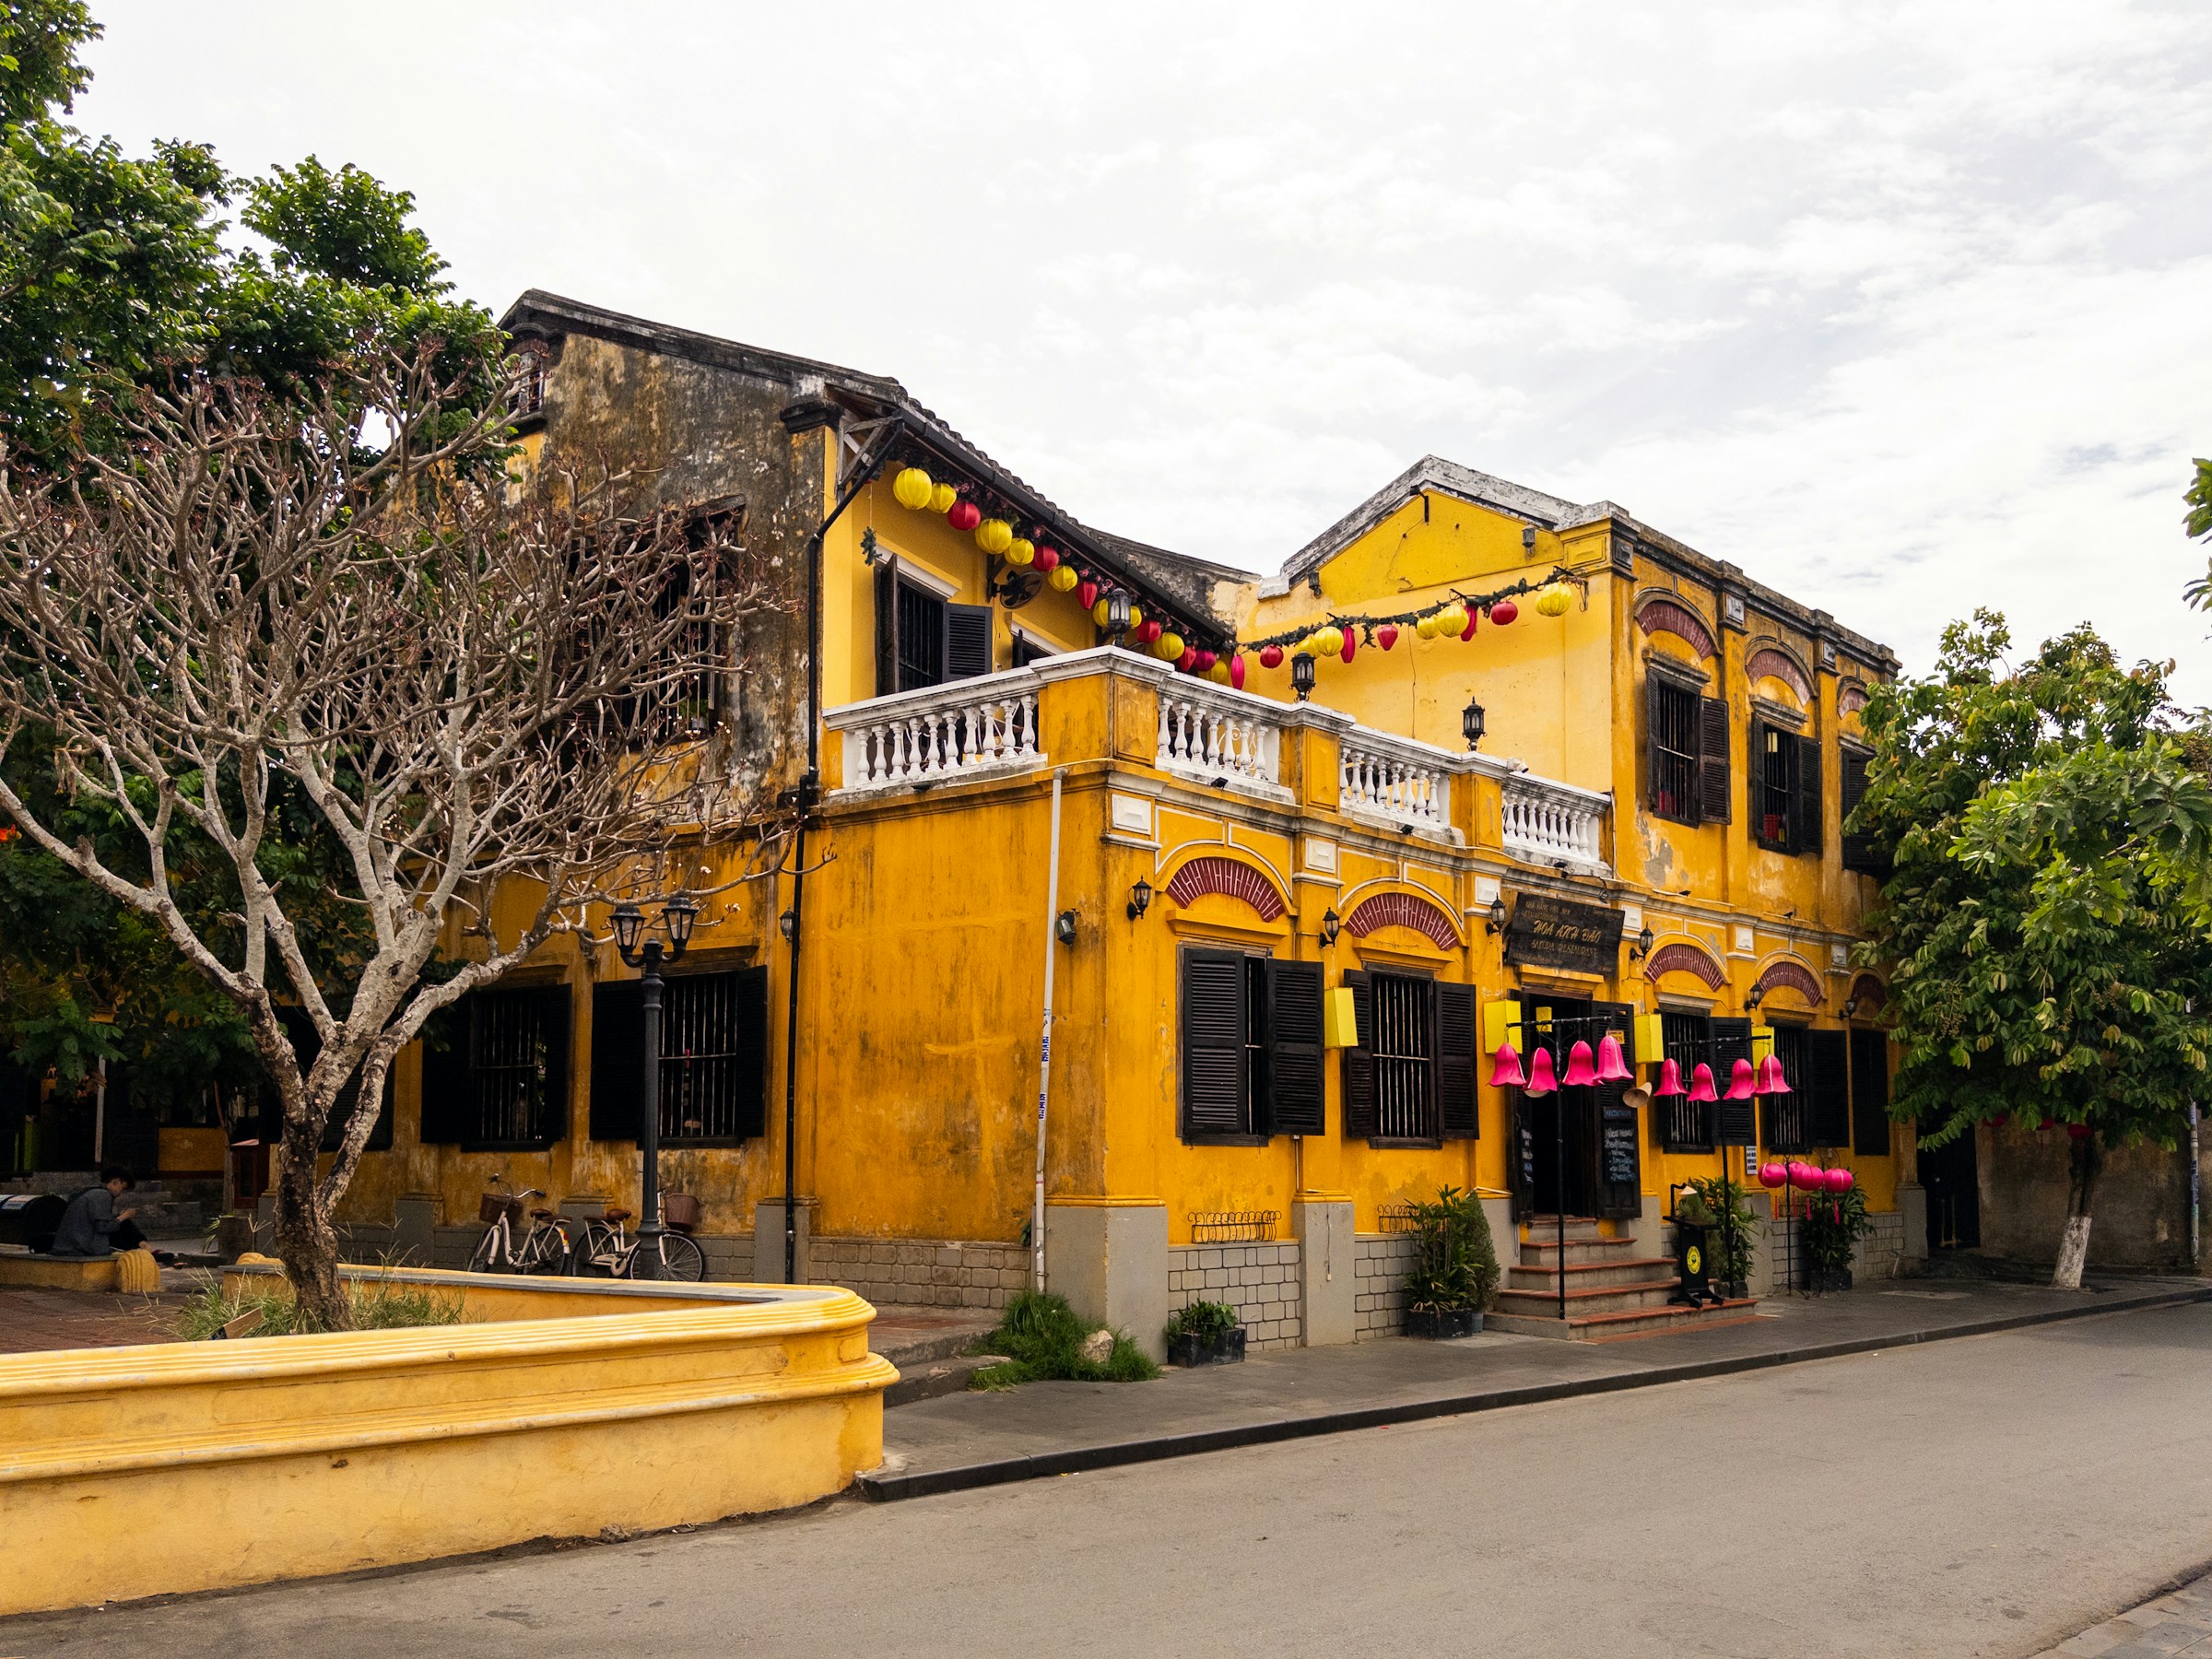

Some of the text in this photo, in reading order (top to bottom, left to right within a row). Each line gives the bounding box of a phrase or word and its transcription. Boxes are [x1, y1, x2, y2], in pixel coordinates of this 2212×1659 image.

[1533, 920, 1555, 935] HOA
[1556, 924, 1580, 939] ANH
[1558, 943, 1597, 958] RESTAURANT
